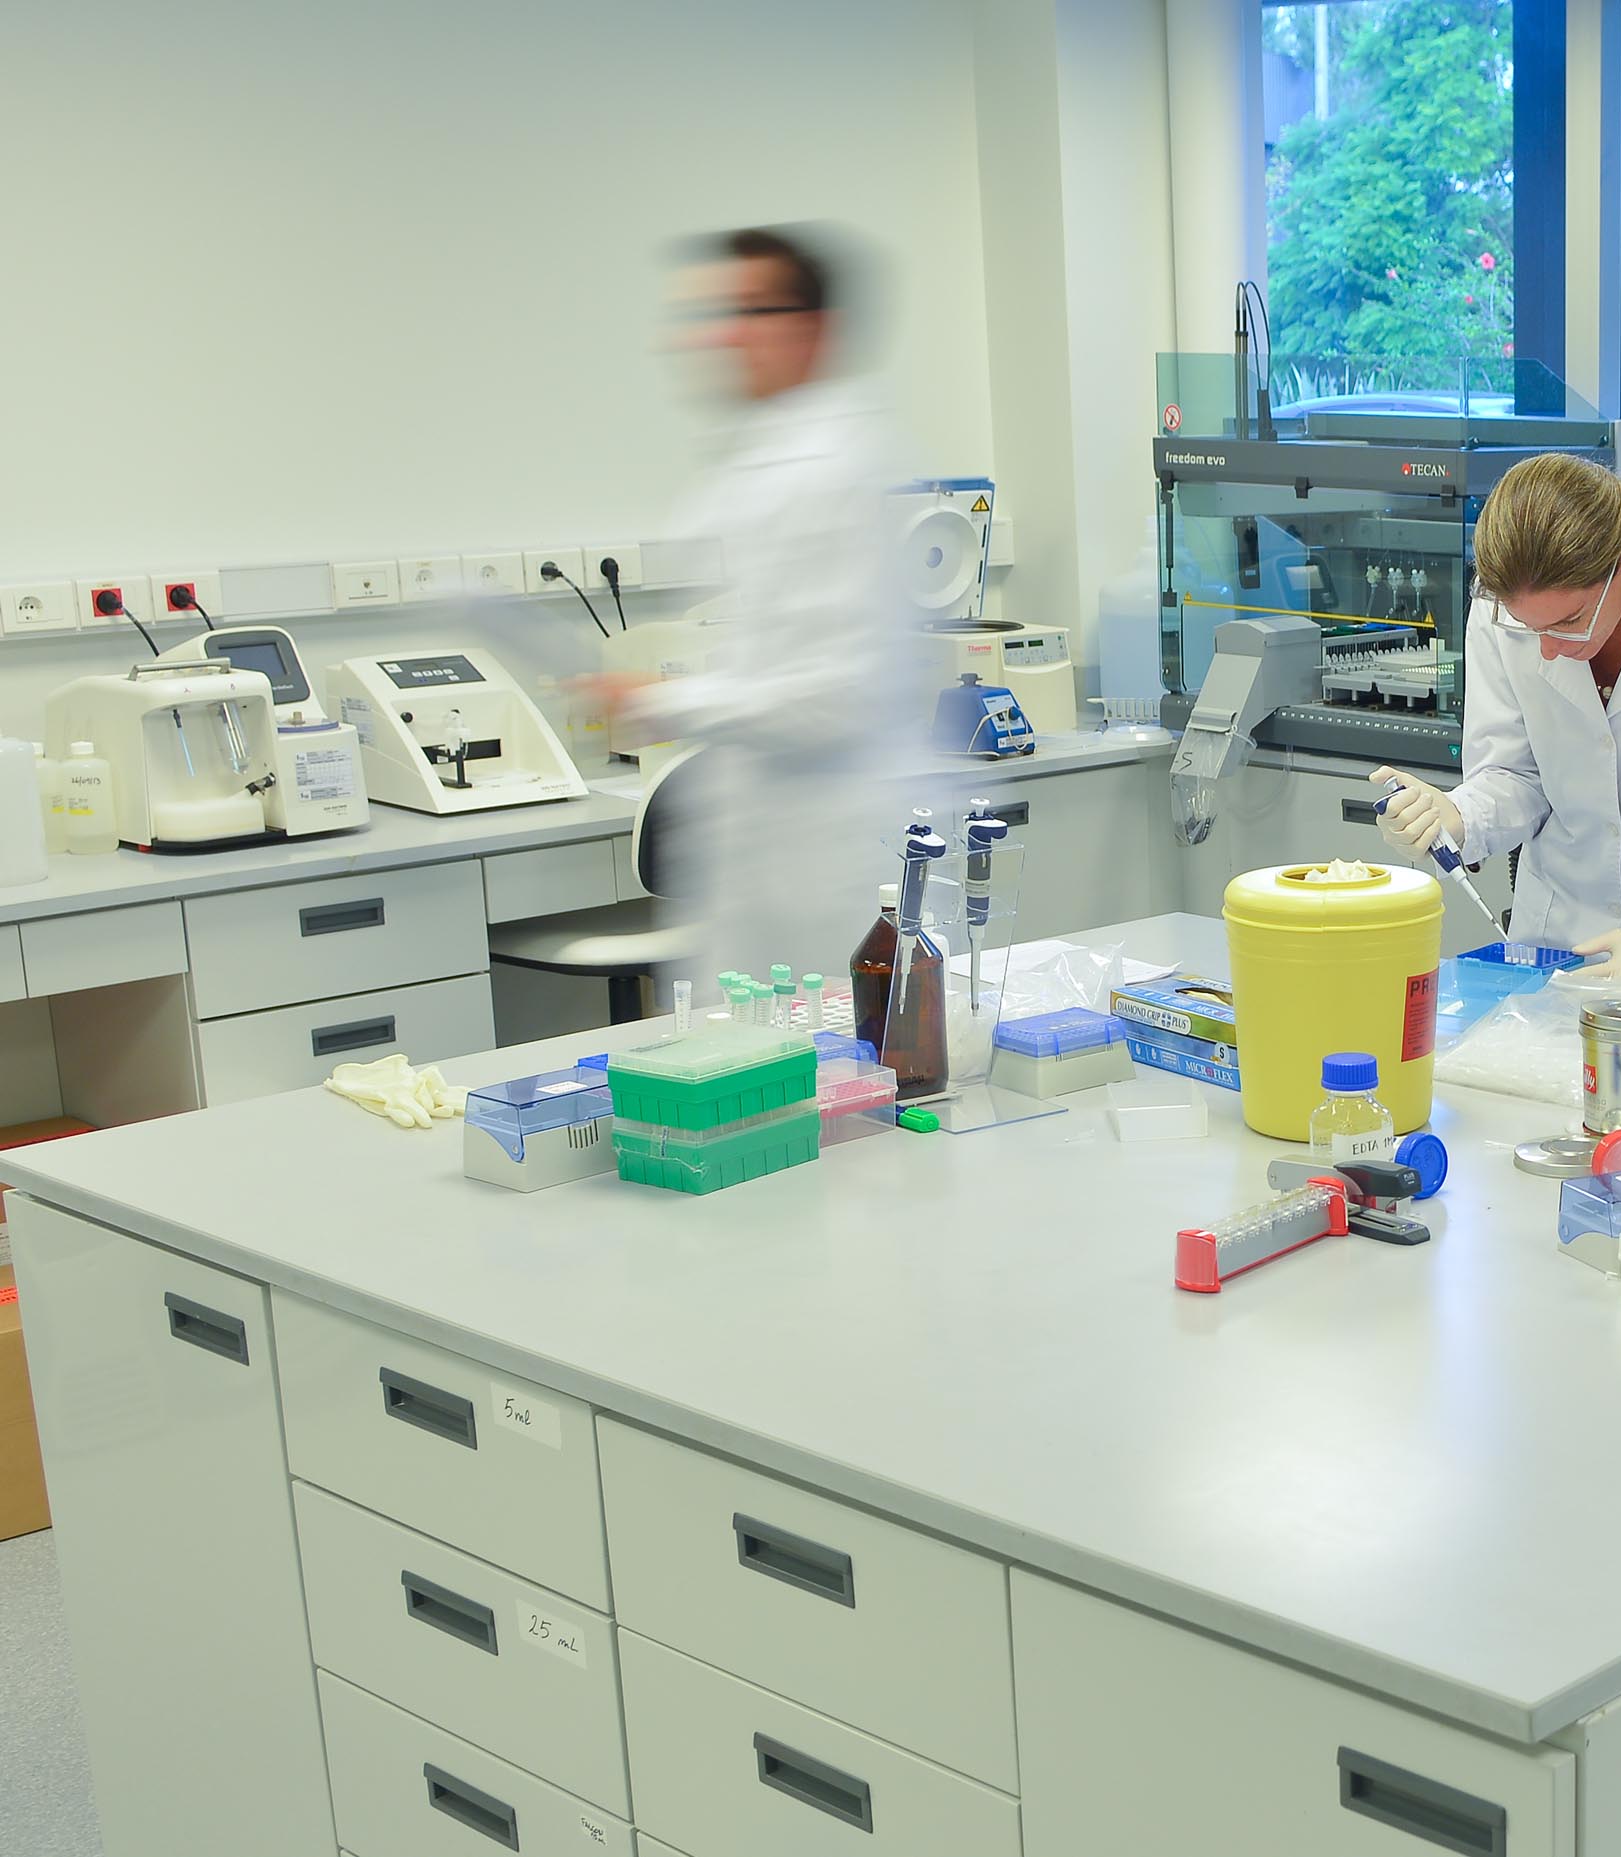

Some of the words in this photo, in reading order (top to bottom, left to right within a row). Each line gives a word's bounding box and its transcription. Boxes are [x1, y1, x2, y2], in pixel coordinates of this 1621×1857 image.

[1165, 451, 1205, 465] freedom
[1206, 455, 1226, 466] evo
[1117, 1000, 1146, 1018] DIAMOND
[1172, 1016, 1187, 1030] PLUS
[1219, 1046, 1225, 1059] S
[1352, 1139, 1379, 1156] EDTA
[528, 1614, 552, 1639] 25
